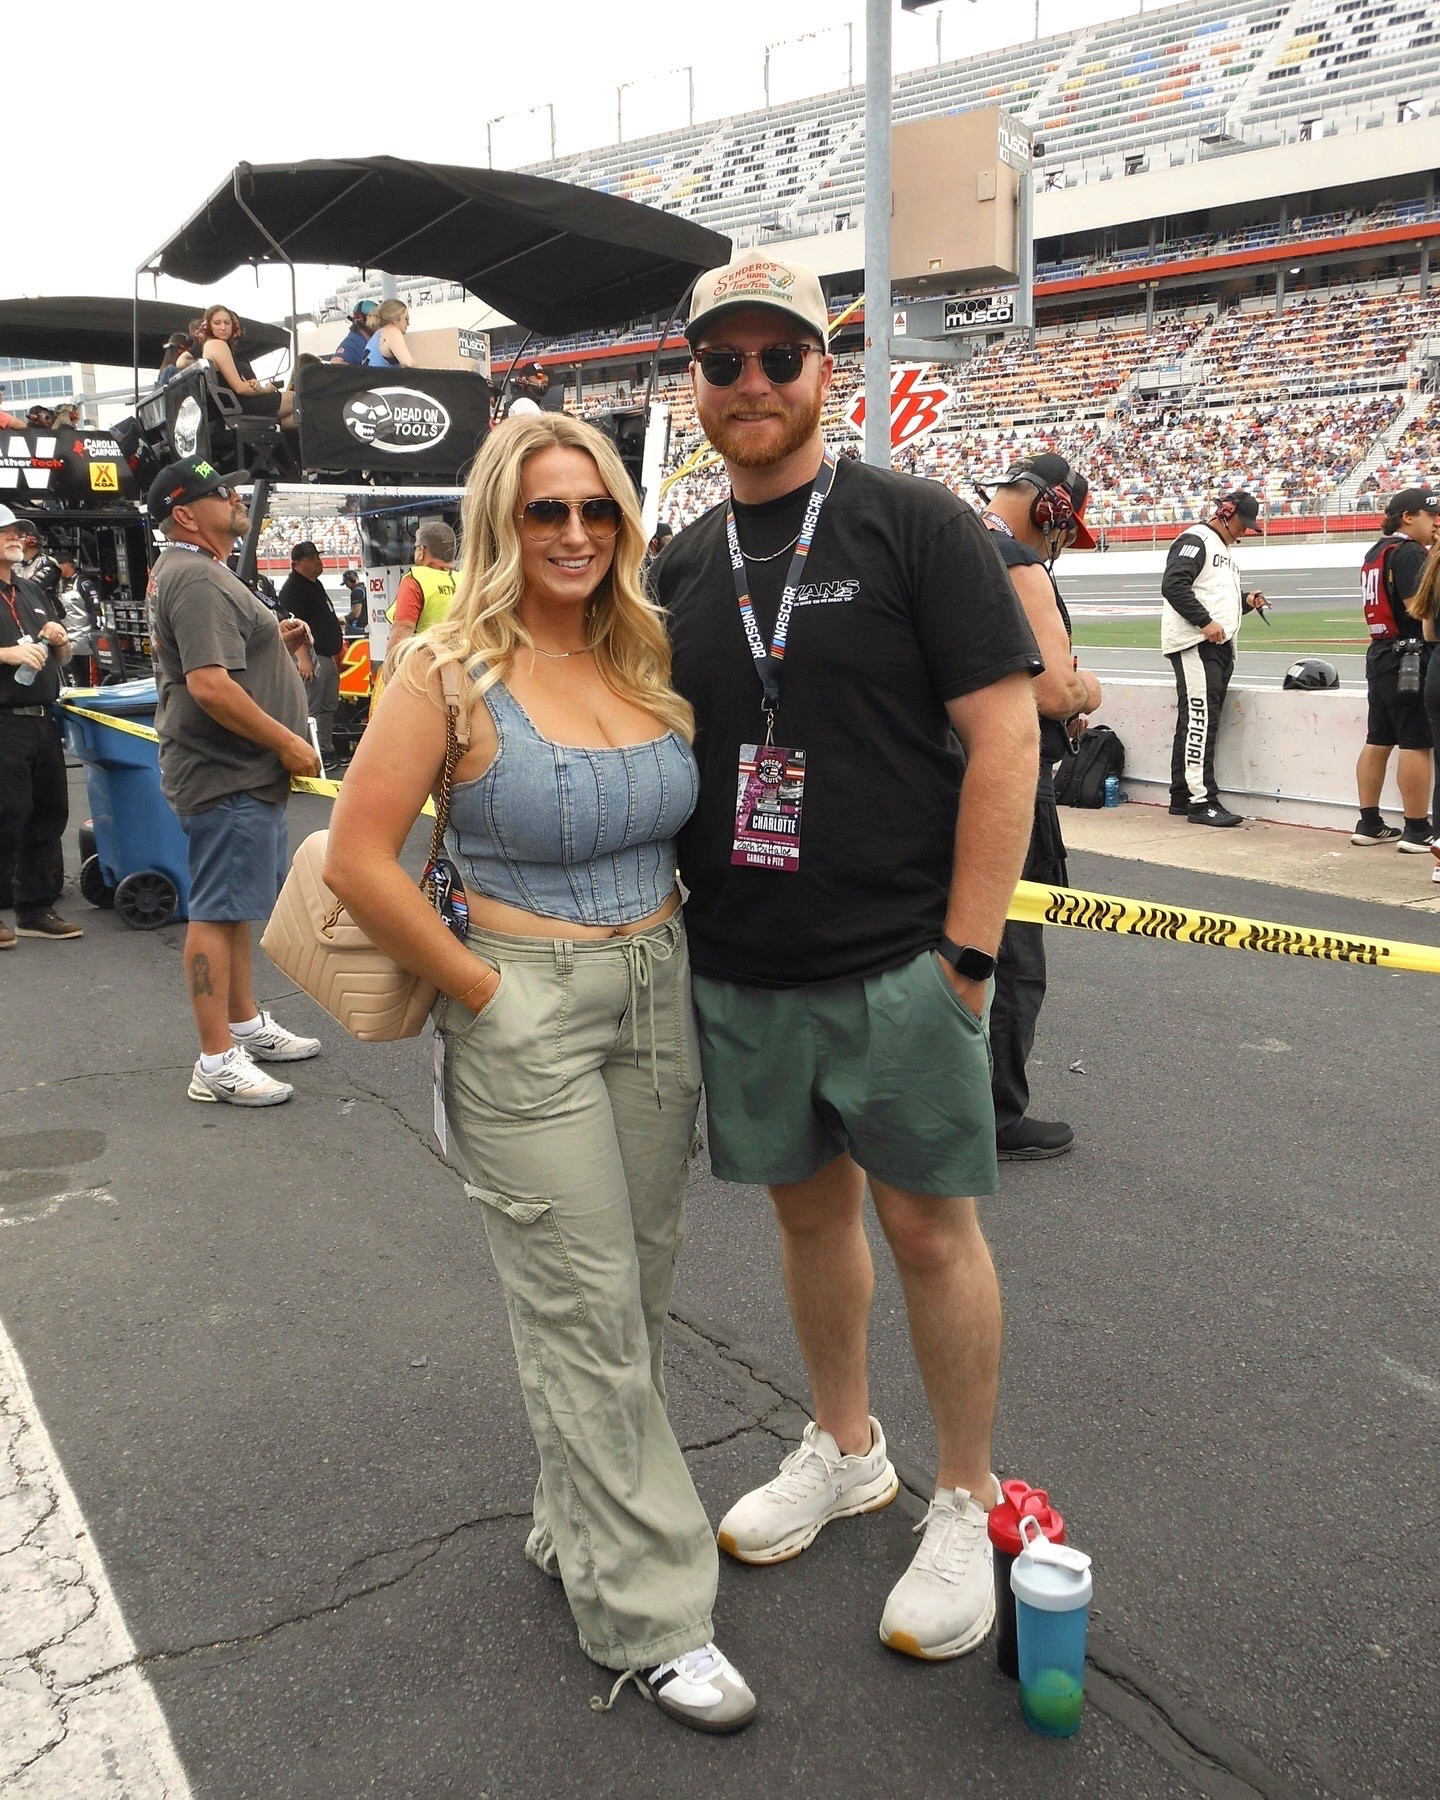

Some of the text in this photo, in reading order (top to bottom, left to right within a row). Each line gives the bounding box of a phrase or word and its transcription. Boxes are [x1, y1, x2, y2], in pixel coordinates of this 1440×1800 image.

[713, 262, 777, 297] SENDERO'S
[996, 295, 1009, 305] 43
[393, 407, 439, 422] DEAD ON
[394, 423, 438, 437] TOOLS
[801, 491, 825, 540] NASCAR
[726, 525, 744, 570] NASCAR
[370, 579, 384, 592] DEX
[775, 586, 797, 641] NASCAR
[740, 610, 767, 659] NASCAR
[1187, 697, 1205, 767] OFFICIAL
[760, 758, 782, 769] NASCAR
[752, 815, 796, 834] CHARLOTTE
[746, 852, 767, 865] GARAGE
[772, 856, 785, 867] PITS
[1045, 891, 1126, 932] ENTER
[1127, 906, 1187, 940] NOT
[1189, 915, 1237, 947] DO
